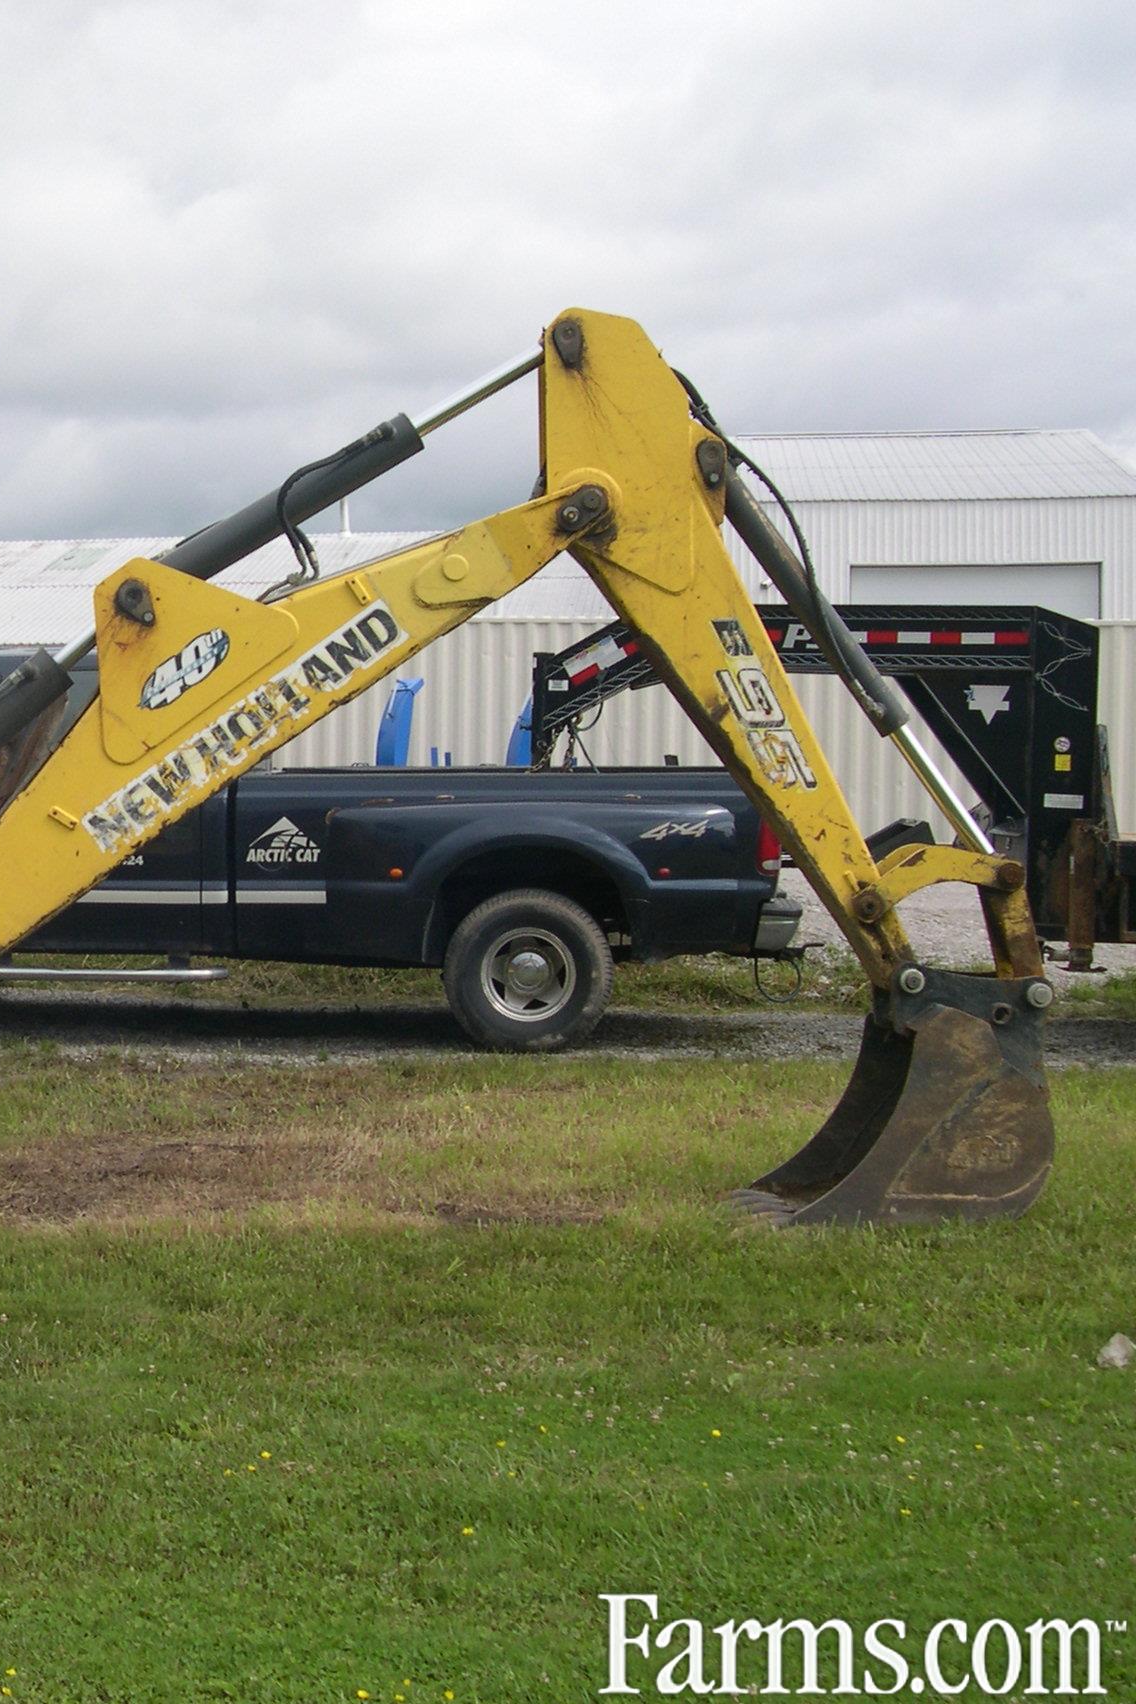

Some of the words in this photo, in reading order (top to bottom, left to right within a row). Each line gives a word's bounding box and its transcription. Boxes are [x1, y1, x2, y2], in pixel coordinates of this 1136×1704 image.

[782, 624, 820, 649] P
[639, 819, 709, 840] 4x4
[246, 848, 293, 862] ARCTIC
[295, 848, 321, 862] CAT
